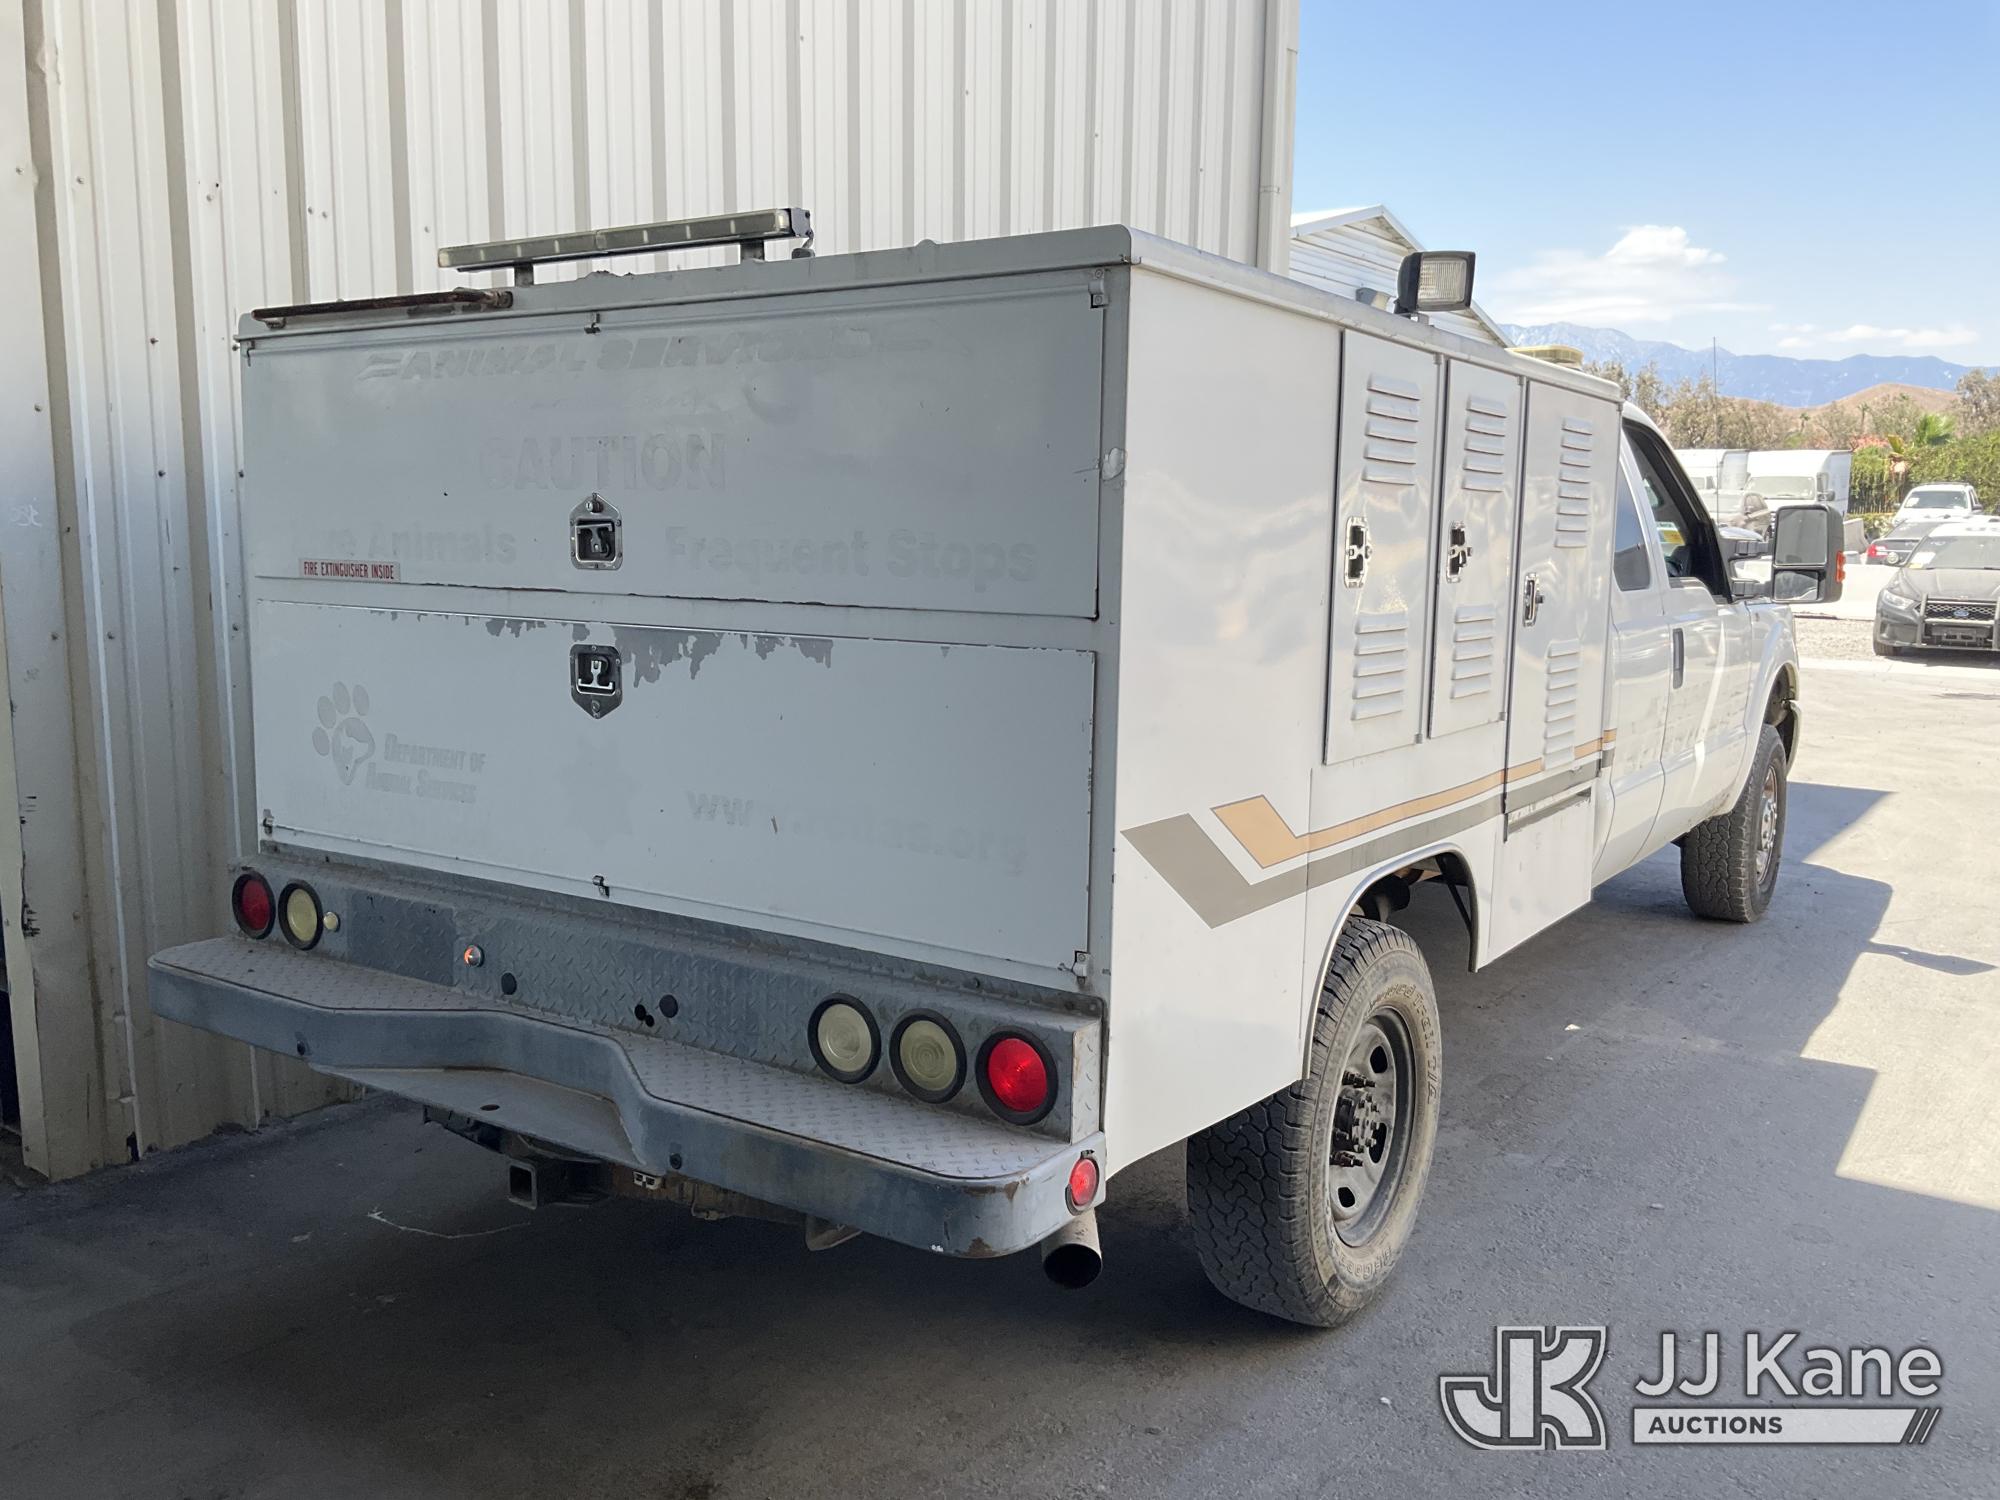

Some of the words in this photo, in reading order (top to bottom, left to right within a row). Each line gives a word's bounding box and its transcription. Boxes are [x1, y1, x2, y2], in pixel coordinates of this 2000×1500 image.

[479, 433, 727, 490] CAUTION
[303, 561, 318, 576] FIRE
[321, 562, 368, 578] EXTINGUISHER
[371, 564, 394, 579] INSIDE
[665, 525, 872, 585] Frequent
[886, 527, 1039, 593] Stops
